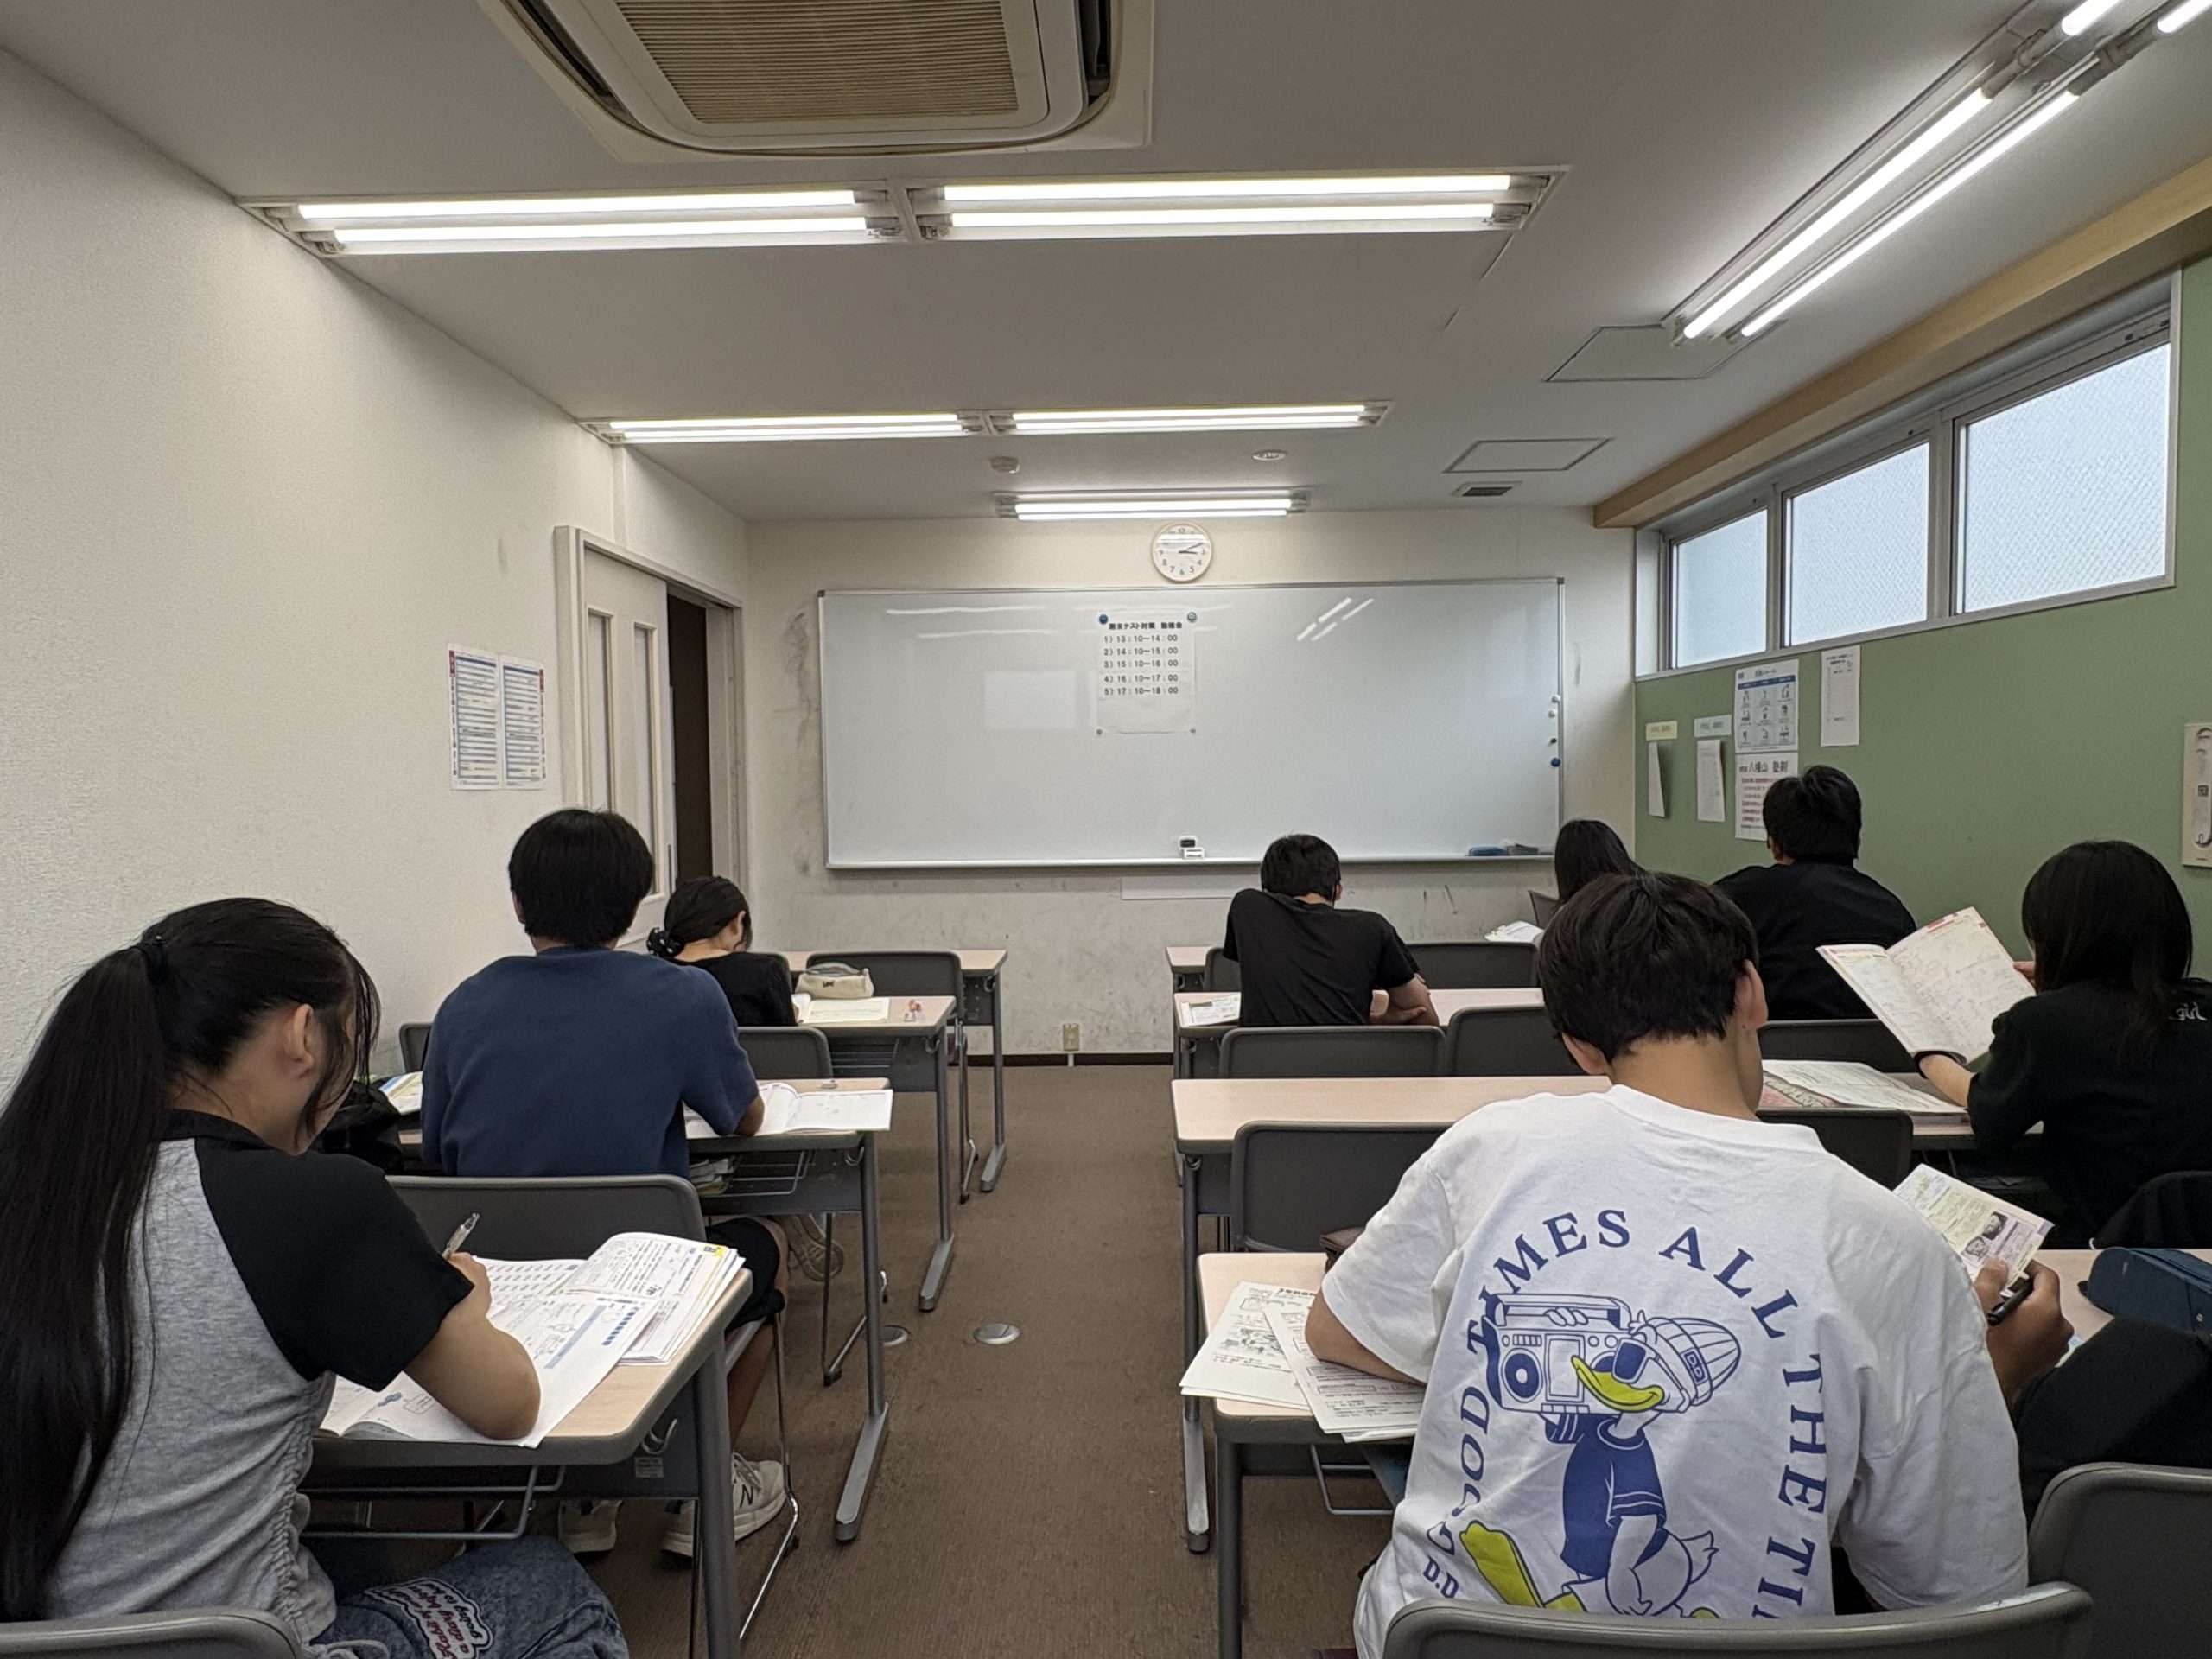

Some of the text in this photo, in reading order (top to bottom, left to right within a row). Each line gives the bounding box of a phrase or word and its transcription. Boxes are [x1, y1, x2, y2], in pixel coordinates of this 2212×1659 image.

[1467, 1210, 1630, 1355] TIMES
[1658, 1226, 1798, 1338] ALL
[1777, 1353, 1827, 1514] THE
[454, 1605, 483, 1639] going
[1751, 1535, 1815, 1618] TI
